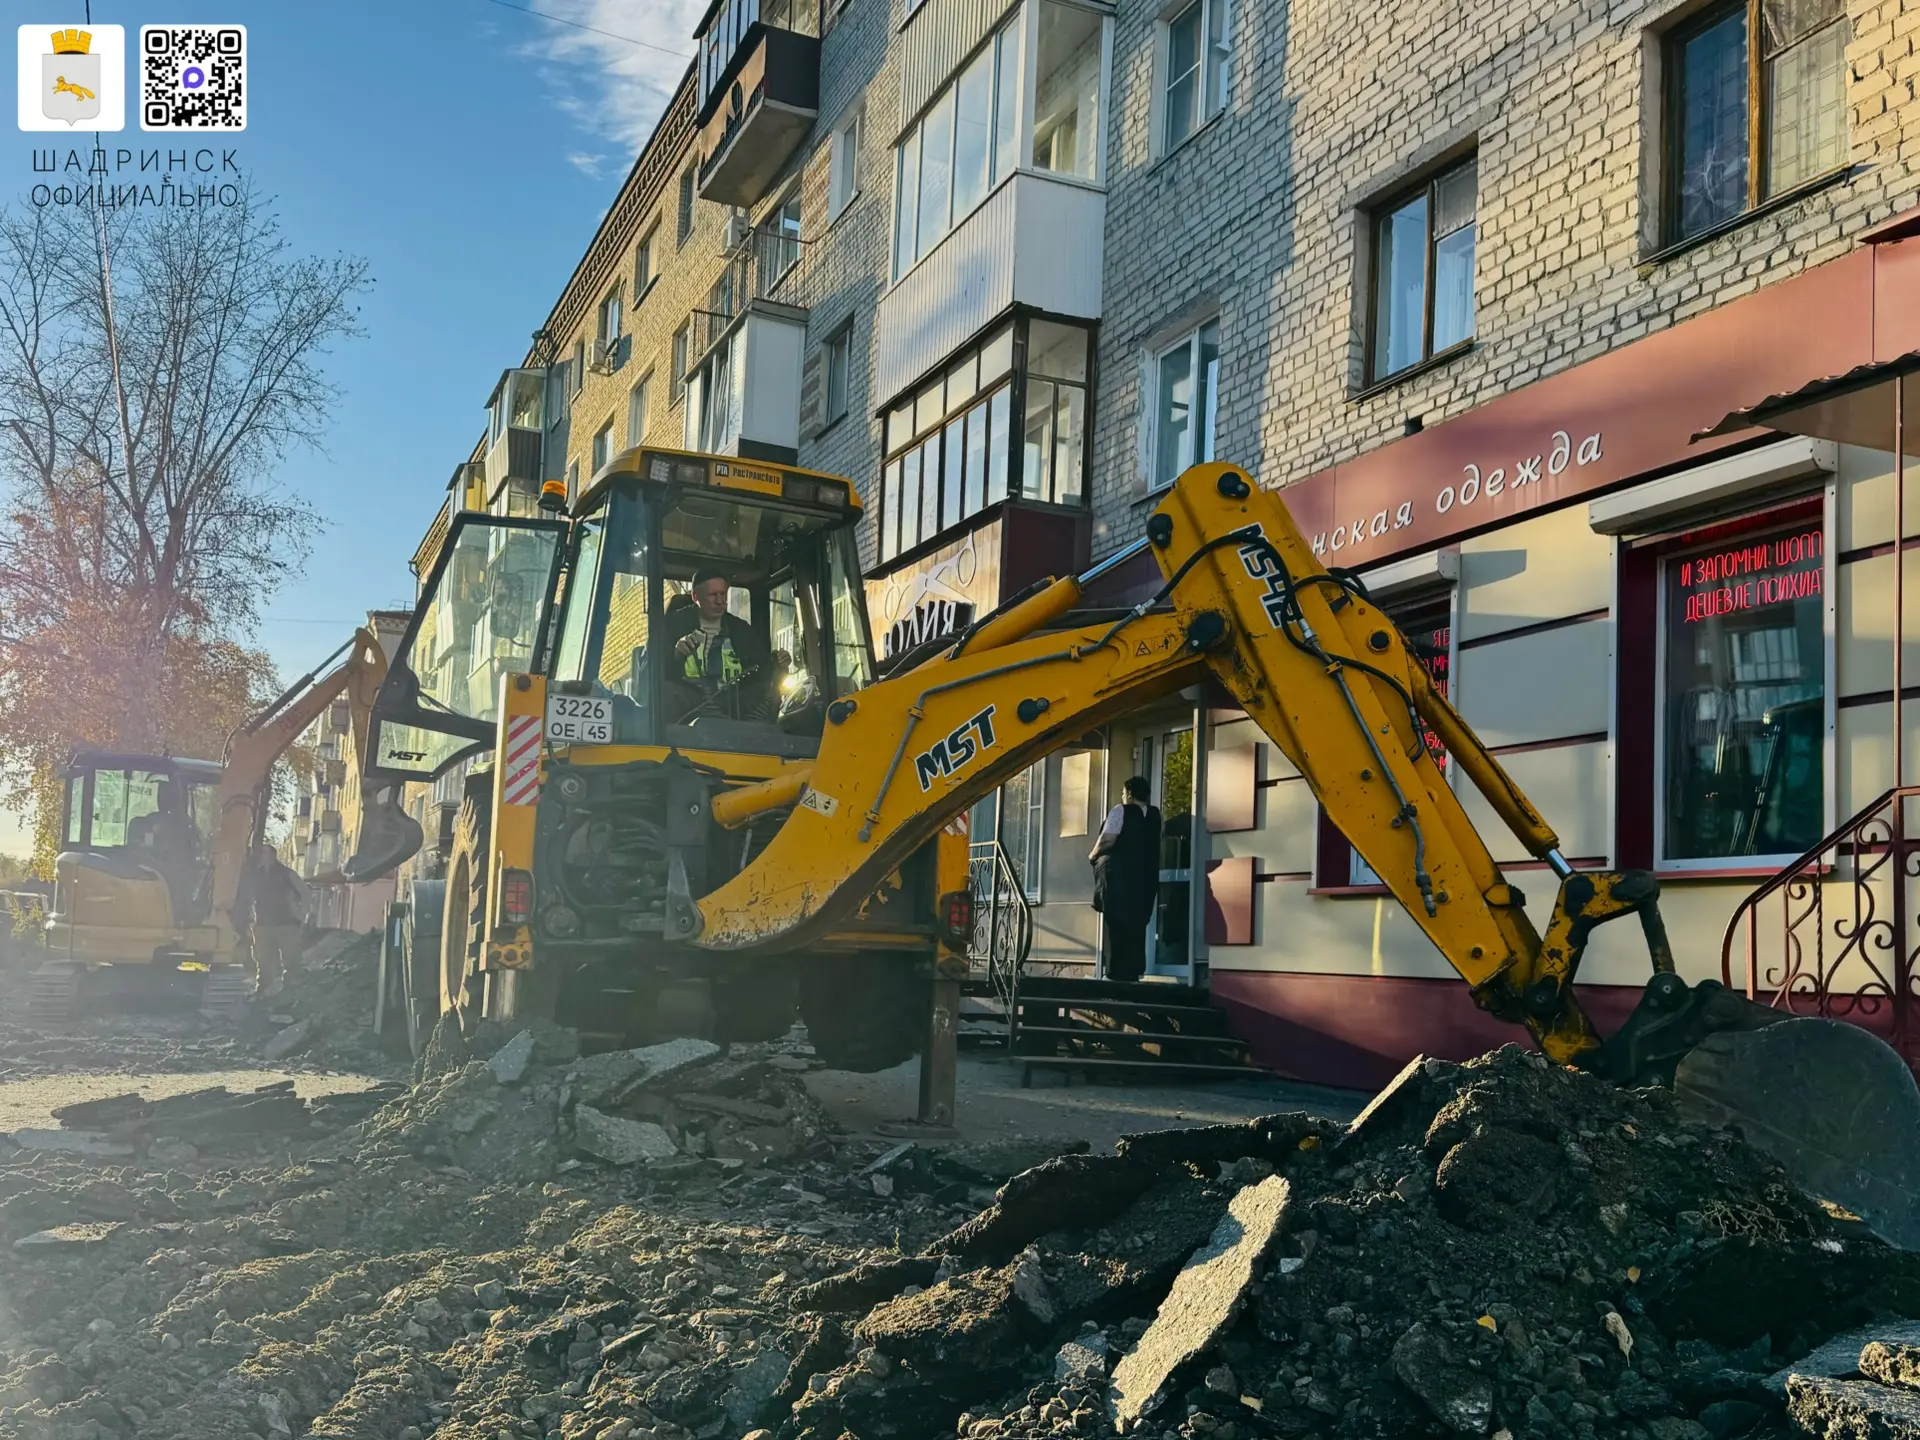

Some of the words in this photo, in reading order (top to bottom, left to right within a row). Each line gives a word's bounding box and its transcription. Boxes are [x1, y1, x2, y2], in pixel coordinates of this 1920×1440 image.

[1436, 430, 1604, 514] одежда
[1681, 562, 1691, 587] И
[1684, 583, 1752, 623] ДЕШЕВЛЕ
[884, 599, 957, 658] ЮЛИЯ
[555, 697, 605, 719] 3226
[587, 725, 607, 740] 45
[914, 703, 996, 792] MST
[387, 749, 427, 762] MST
